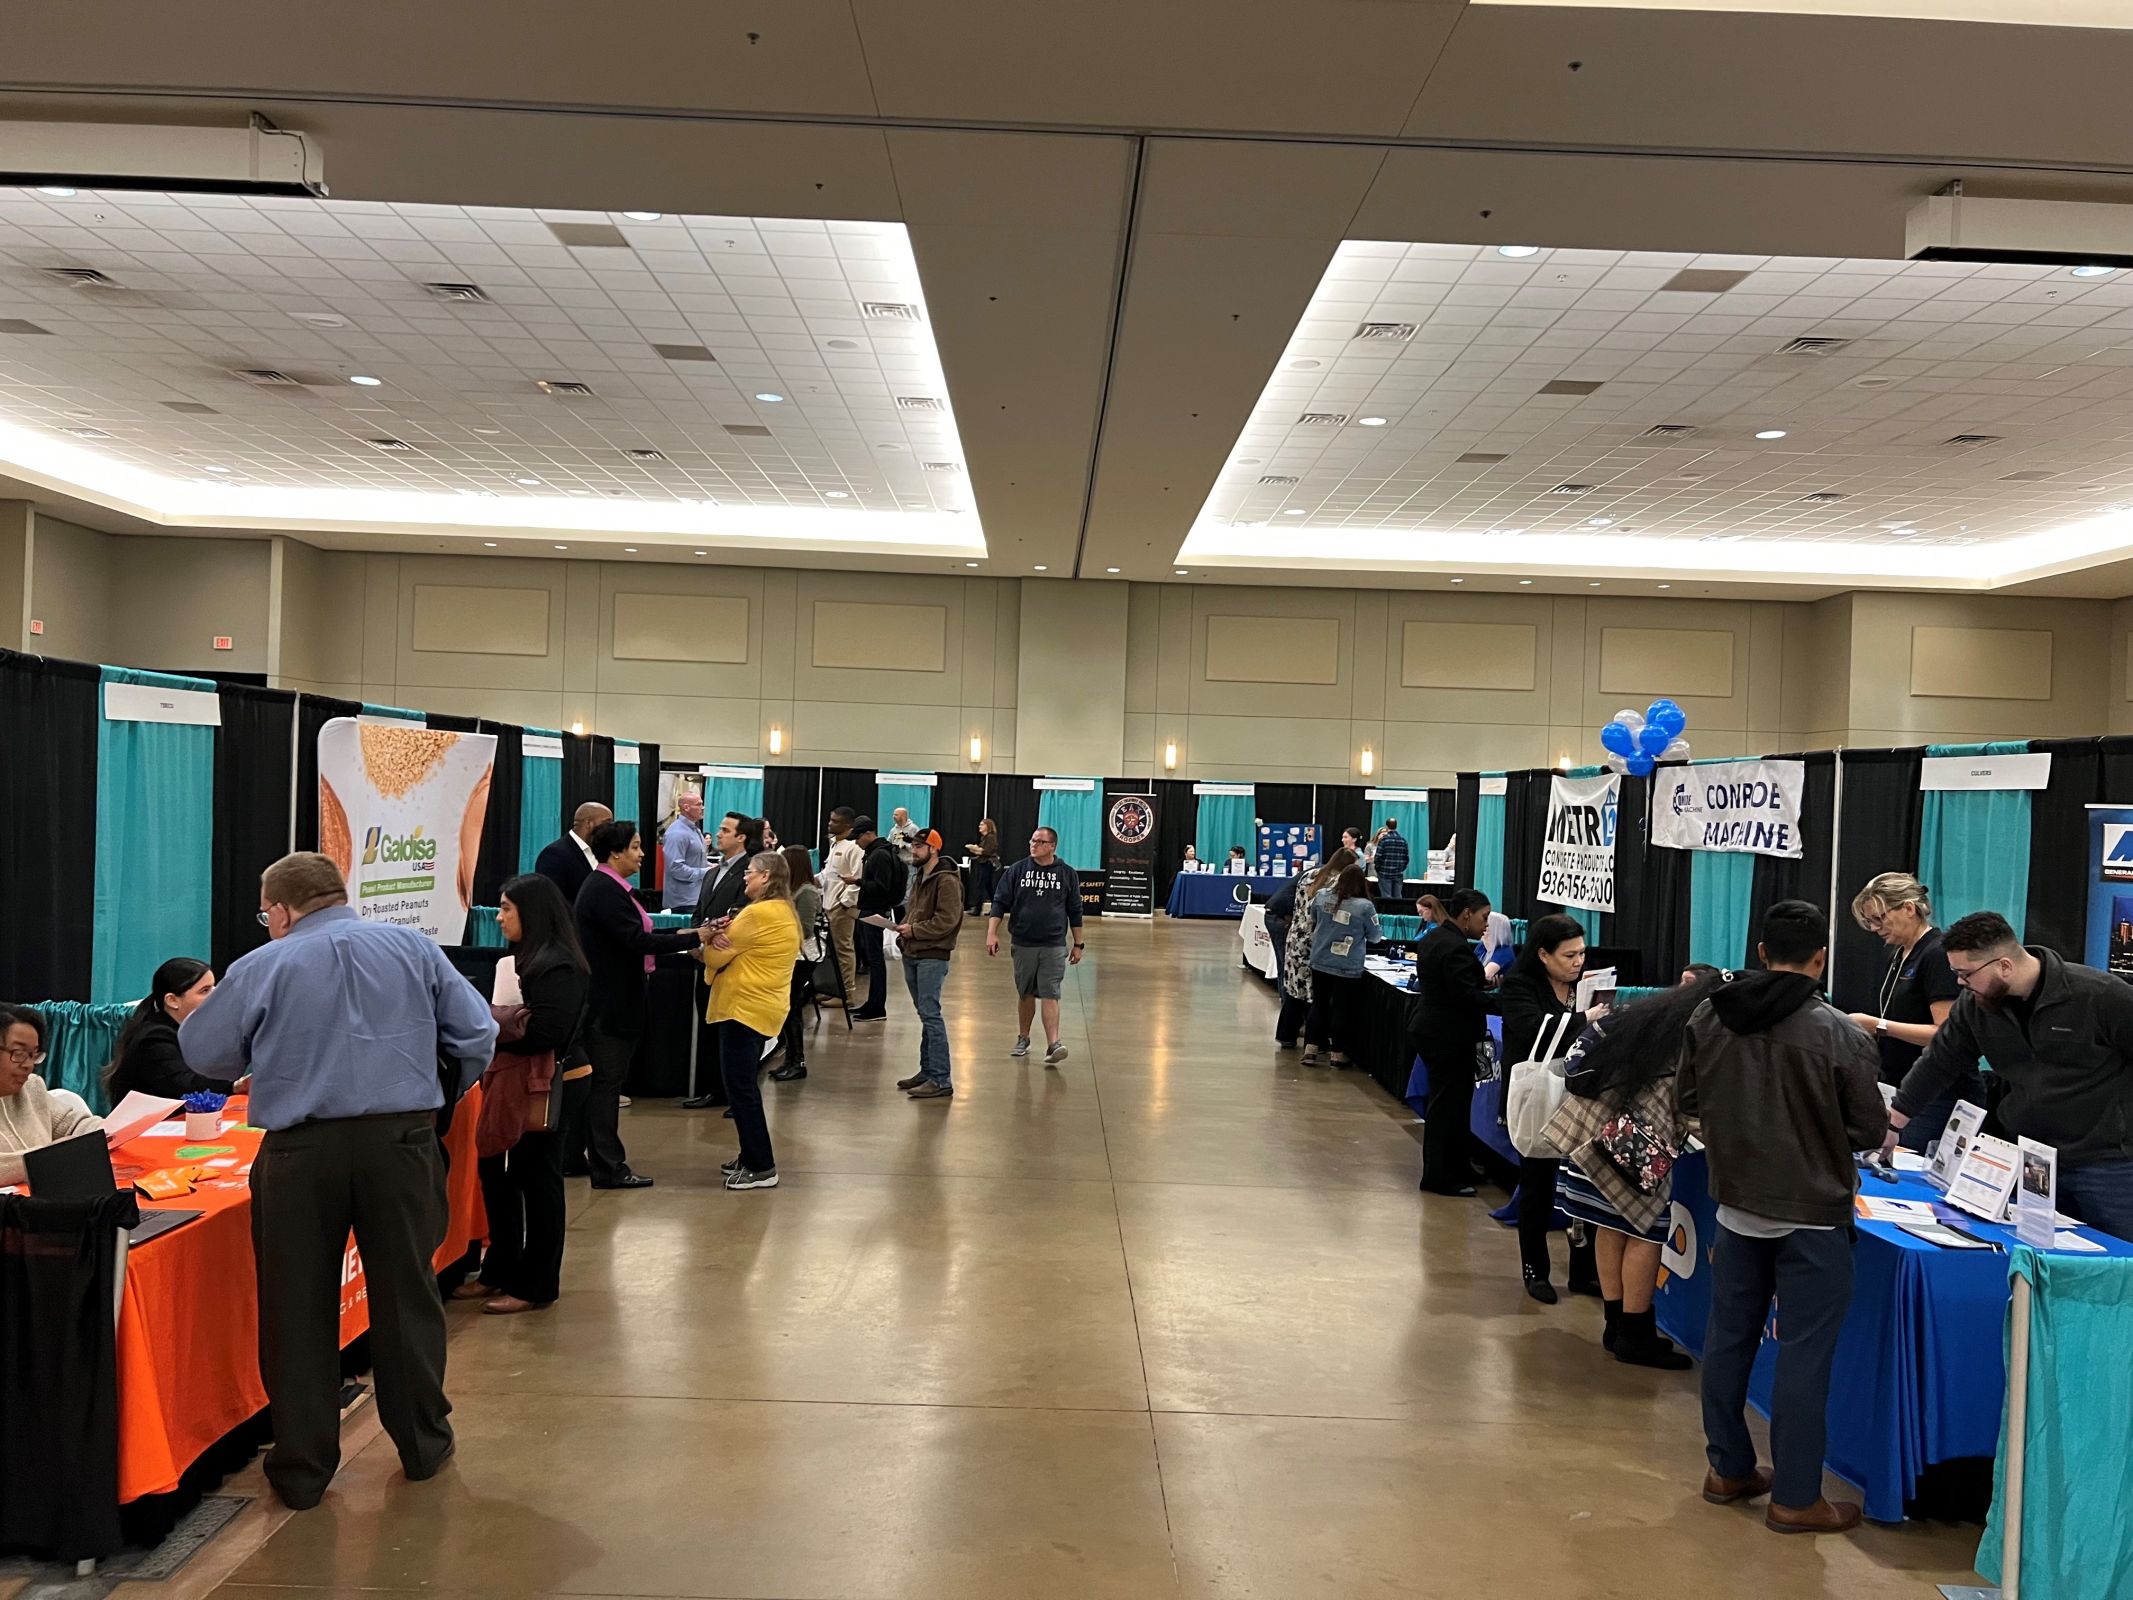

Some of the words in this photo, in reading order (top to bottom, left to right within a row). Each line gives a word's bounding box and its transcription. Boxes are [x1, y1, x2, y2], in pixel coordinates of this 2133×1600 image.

[1706, 781, 1781, 809] CONROE
[1703, 820, 1789, 851] MACHINE
[381, 834, 437, 863] Galdisa
[412, 862, 426, 872] USA
[362, 905, 372, 917] Dry
[373, 901, 399, 914] Roasted
[400, 899, 429, 911] Peanuts
[1080, 895, 1100, 903] OPER
[389, 914, 420, 925] Granules
